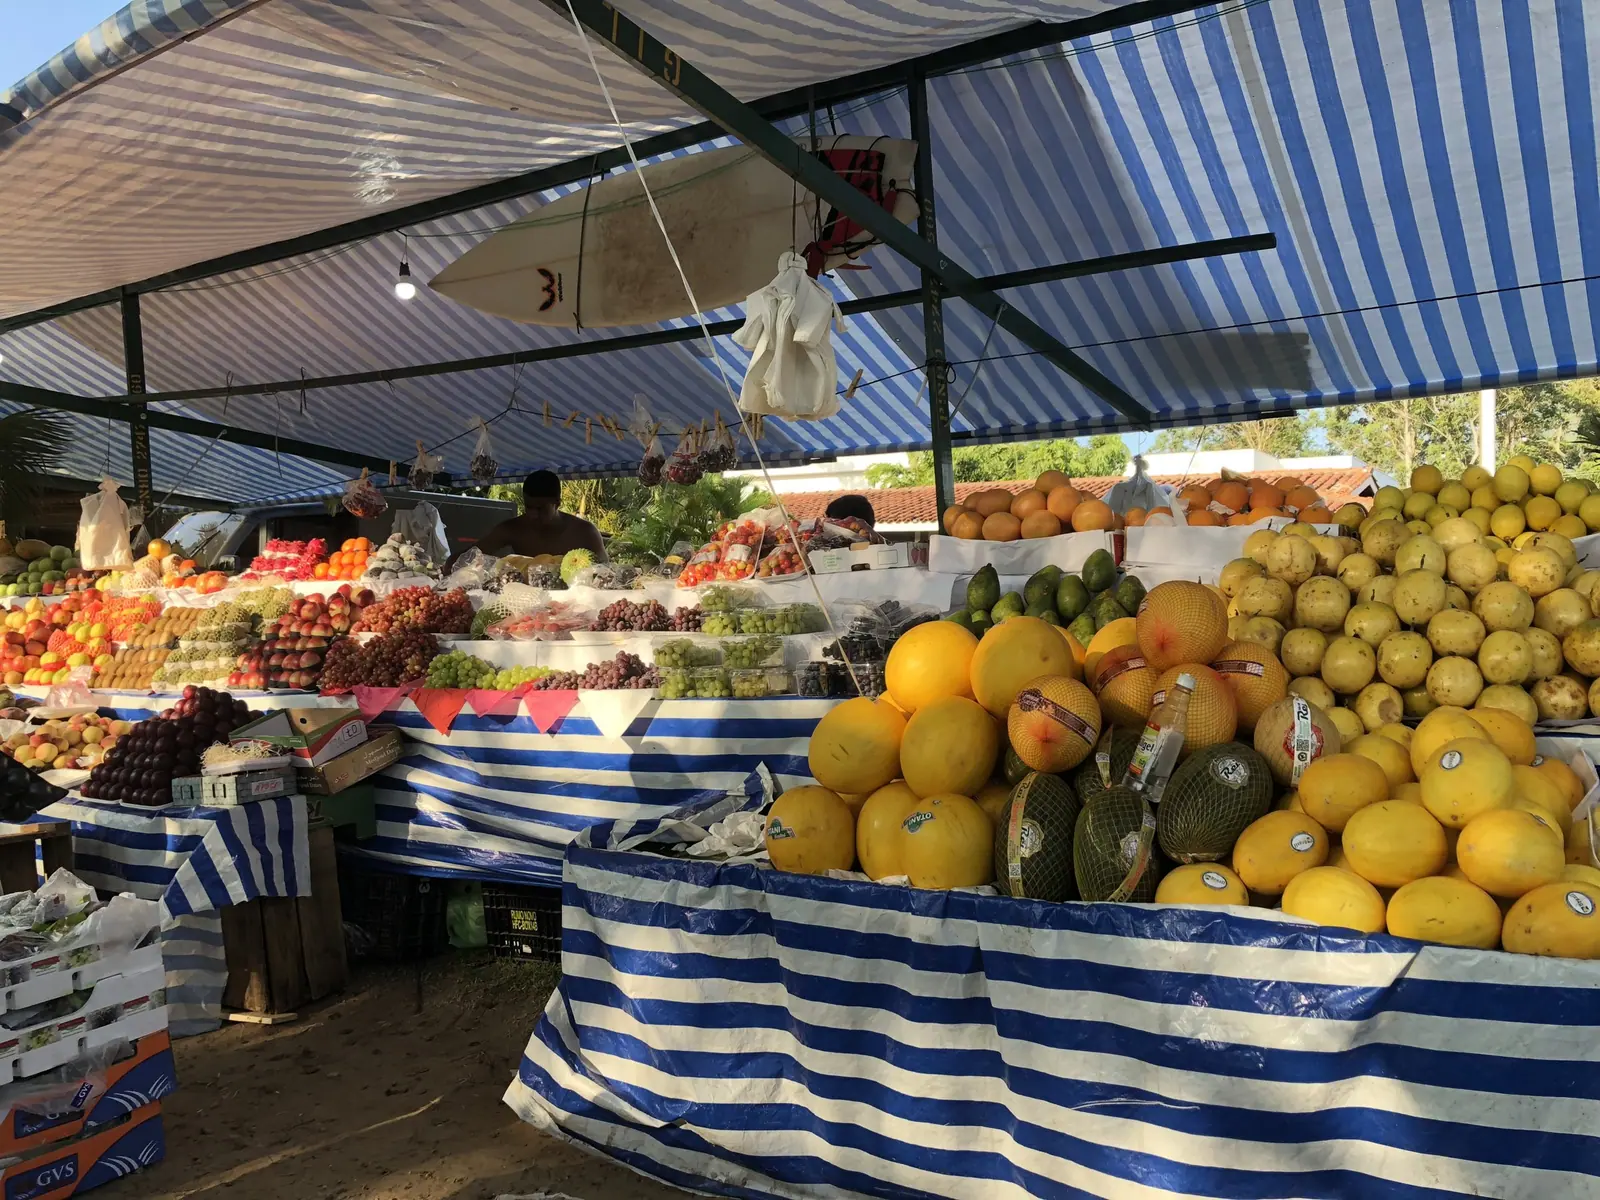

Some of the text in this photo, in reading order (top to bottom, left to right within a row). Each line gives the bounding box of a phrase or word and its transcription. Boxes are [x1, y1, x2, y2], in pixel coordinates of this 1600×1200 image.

[1220, 759, 1240, 779] Rei
[907, 812, 933, 827] OTANI
[79, 1083, 91, 1098] GVS
[37, 1161, 74, 1187] GVS
